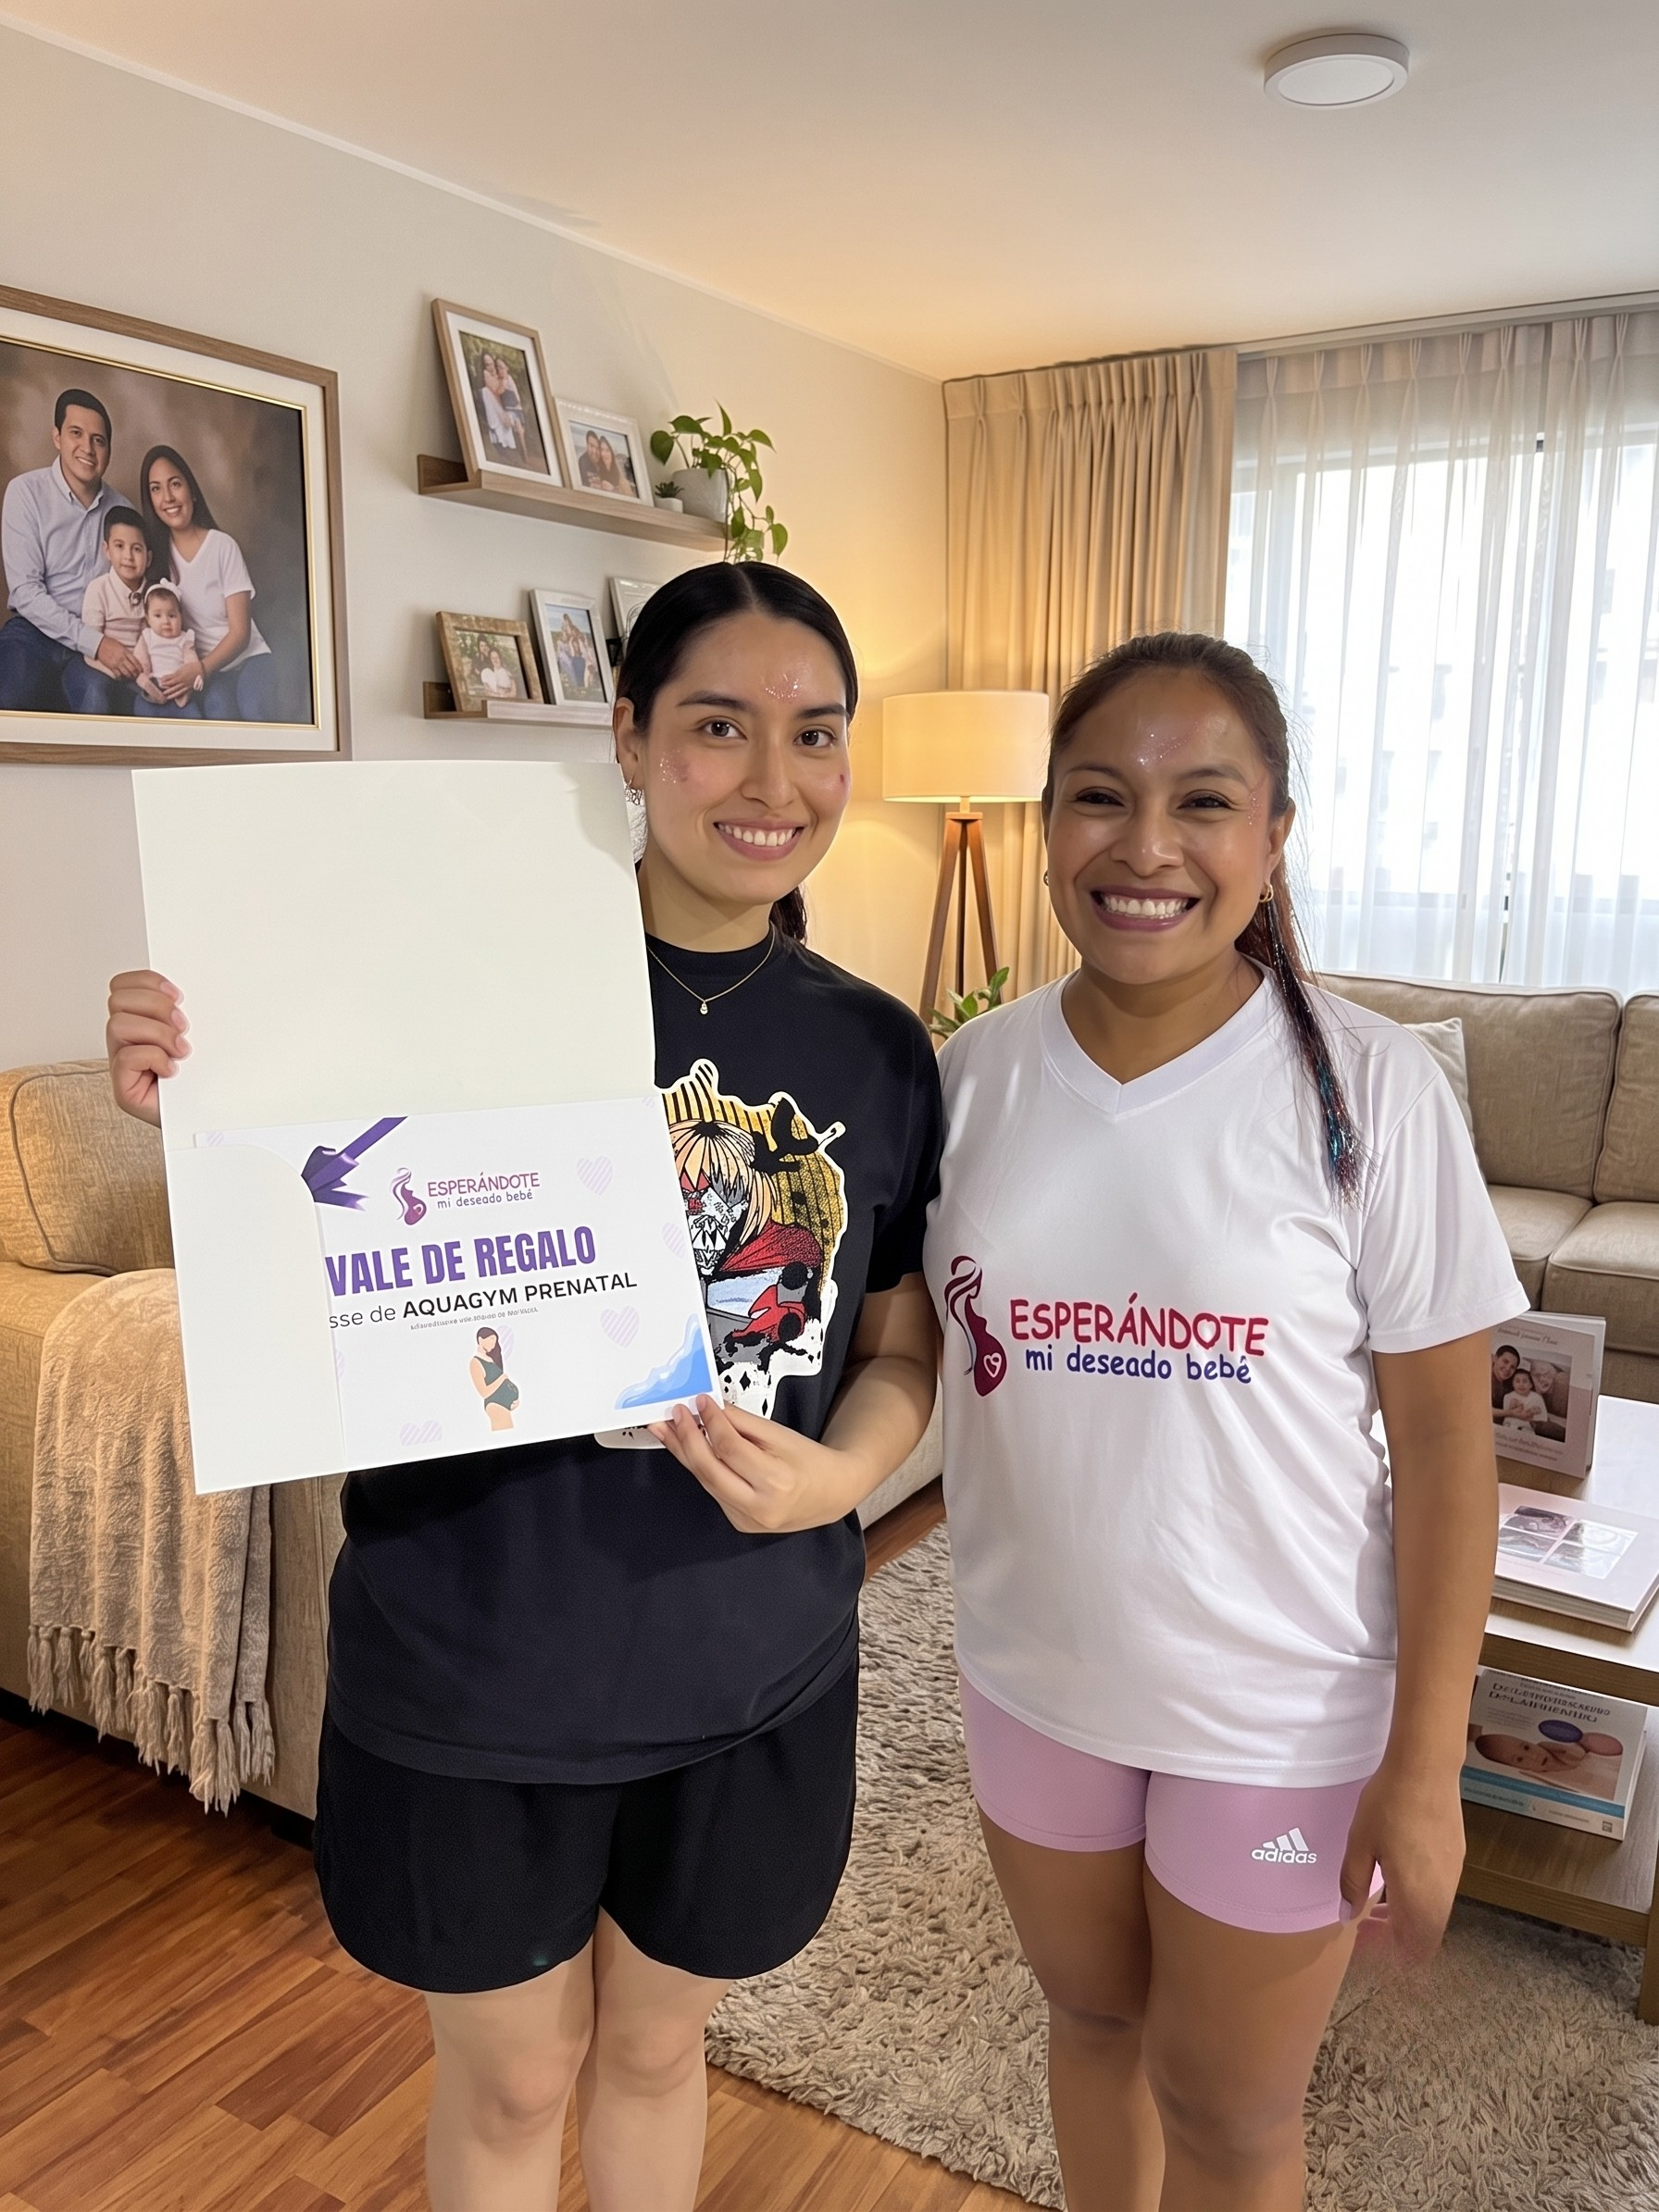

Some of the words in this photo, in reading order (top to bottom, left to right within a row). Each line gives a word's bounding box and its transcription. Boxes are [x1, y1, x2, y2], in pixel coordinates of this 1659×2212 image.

[427, 1172, 540, 1197] ESPERÁNDOTE
[437, 1198, 451, 1209] mi
[455, 1194, 502, 1207] deseado
[505, 1189, 533, 1201] bebé
[325, 1247, 413, 1296] VALE
[421, 1241, 466, 1284] DE
[474, 1226, 596, 1277] REGALO
[369, 1305, 396, 1323] de
[403, 1287, 518, 1318] AQUAGYM
[524, 1273, 638, 1301] PRENATAL
[1010, 1292, 1269, 1357] ESPERÁNDOTE
[1025, 1344, 1053, 1372] mi
[1066, 1345, 1172, 1379] deseado
[1251, 1848, 1317, 1864] adidas
